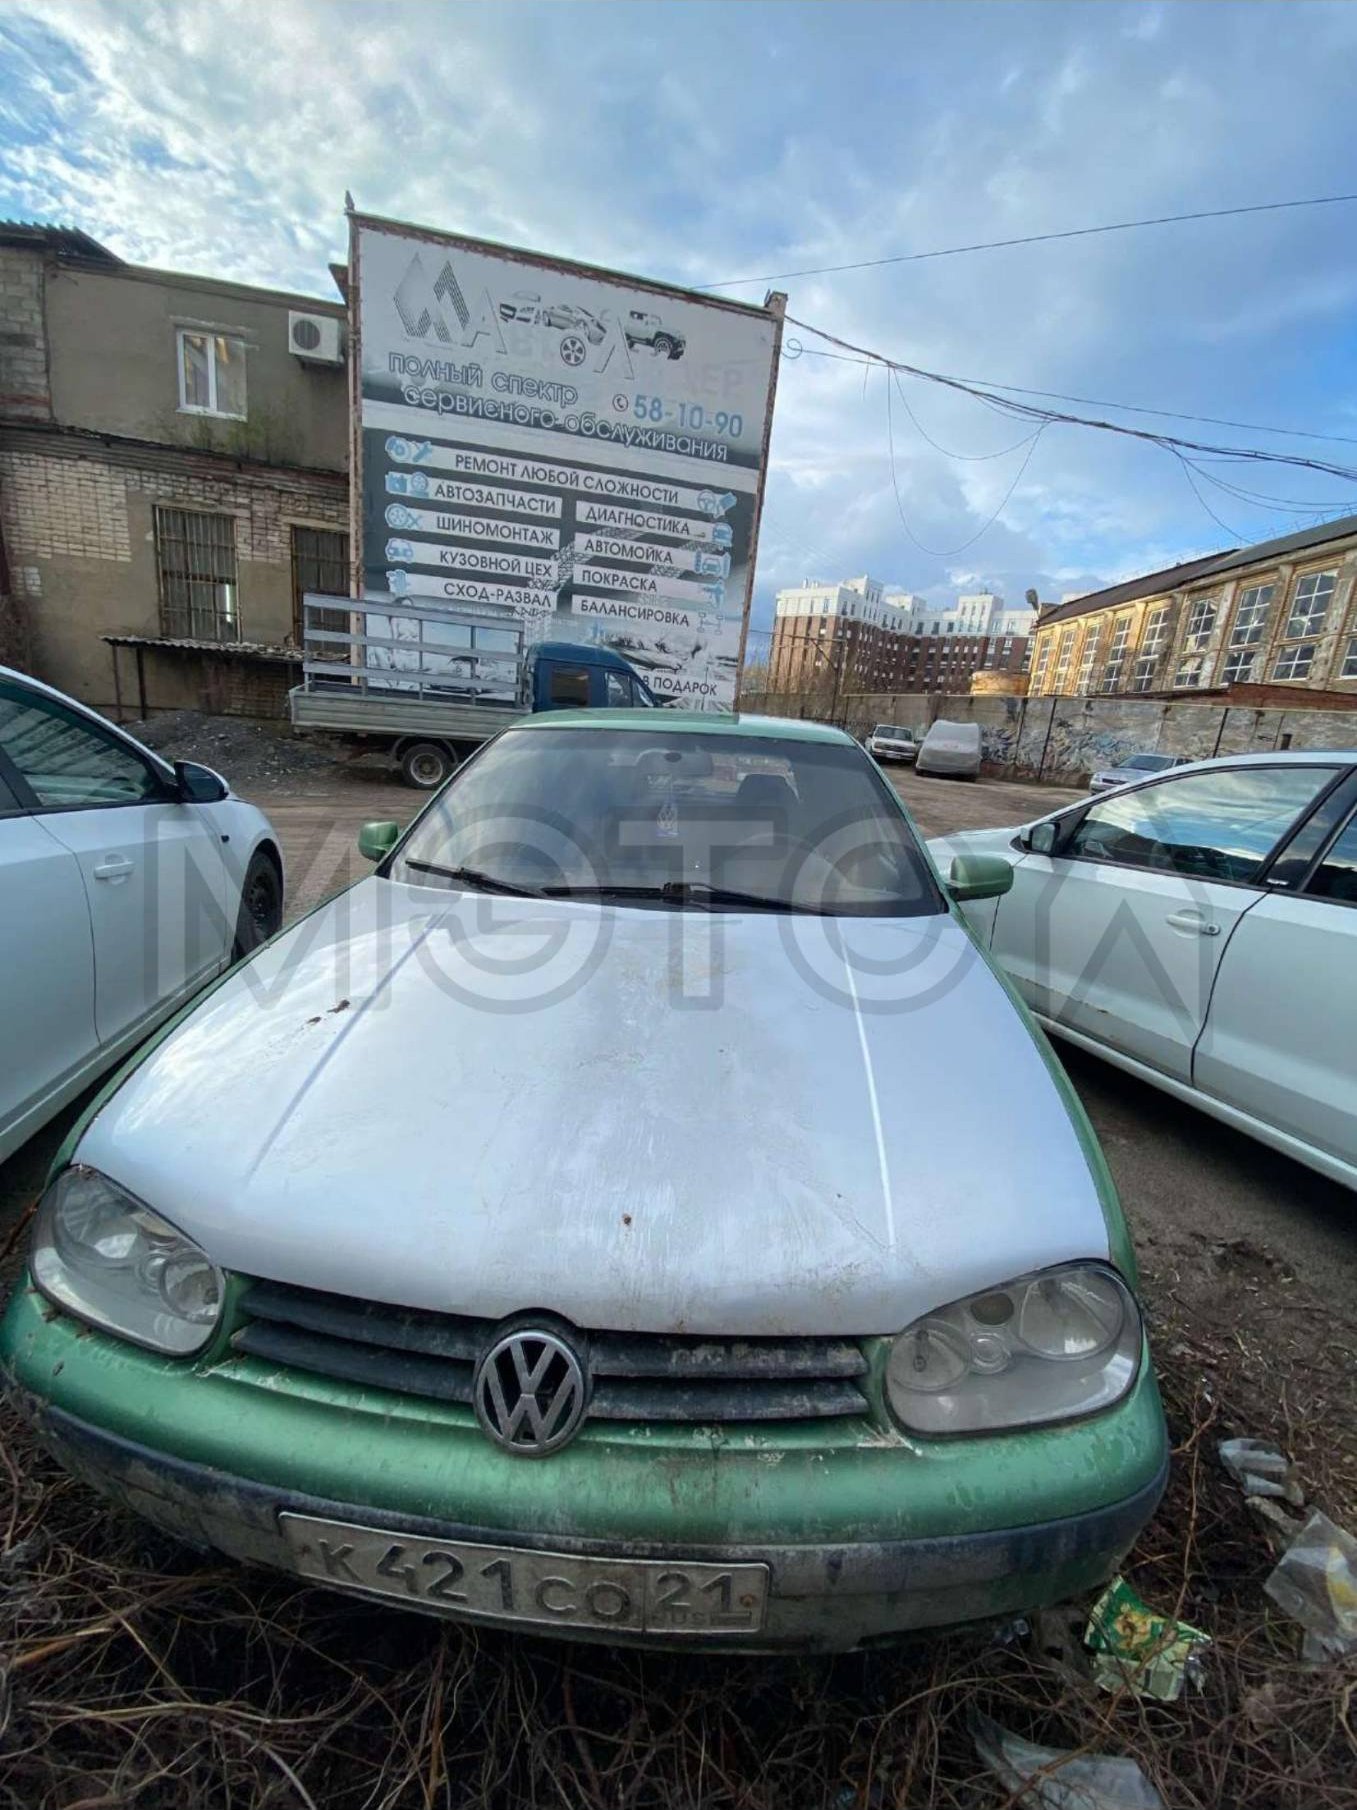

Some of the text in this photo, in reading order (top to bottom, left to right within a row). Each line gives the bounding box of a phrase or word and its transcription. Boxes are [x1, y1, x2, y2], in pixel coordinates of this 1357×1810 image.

[633, 394, 743, 438] 58-10-90
[455, 454, 678, 504] РЕМОНТ ЛЮБОЙ СЛОЖНОСТИ
[434, 483, 556, 514] АВТОЗАПЧАСТИ
[436, 516, 553, 545] ШИНОМОНТАЖ
[585, 506, 690, 535] ДИАГНОСТИКА
[439, 550, 552, 577] КУЗОВНОЙ ЦЕХ
[584, 538, 673, 565] АВТОМОЙКА
[443, 582, 552, 607] СХОД-РАЗВАЛ
[582, 570, 658, 592] ПОКРАСКА
[580, 599, 690, 627] БАЛАНСИРОВКА
[653, 676, 718, 696] ПОДАРОК
